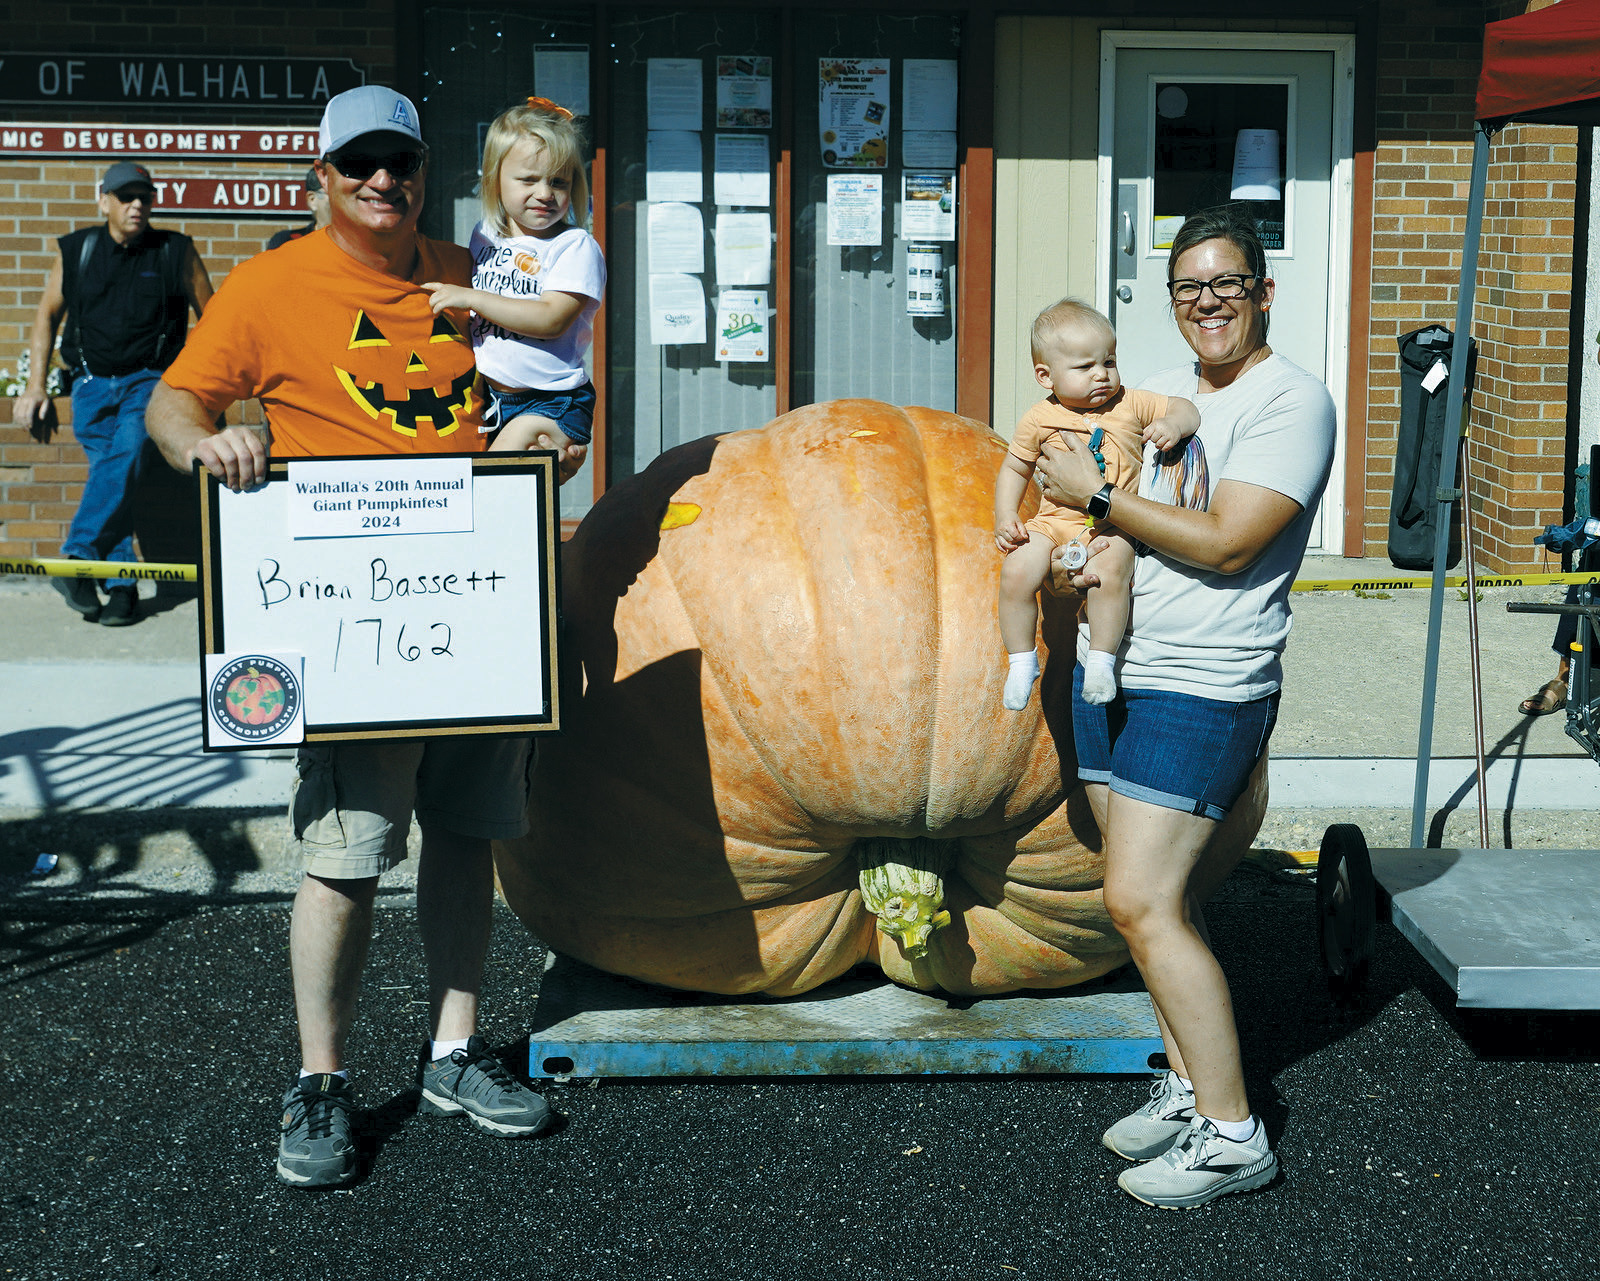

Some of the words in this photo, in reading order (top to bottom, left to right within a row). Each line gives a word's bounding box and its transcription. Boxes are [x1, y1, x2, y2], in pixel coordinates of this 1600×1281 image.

[39, 61, 86, 95] OF
[119, 61, 331, 100] WALHALLA
[393, 100, 412, 126] A
[63, 130, 242, 151] DEVELOPMENT
[259, 133, 320, 151] OFFI
[1256, 232, 1280, 240] PROUD
[728, 313, 754, 329] 30
[295, 480, 370, 495] Walhalla's
[374, 479, 410, 493] 20th
[413, 478, 465, 491] Annual
[313, 499, 352, 512] Giant
[356, 496, 449, 513] Pumpkinfest
[361, 516, 401, 529] 2024
[256, 558, 353, 610] Brian
[370, 558, 507, 603] Bassett
[333, 617, 455, 673] 1762
[216, 662, 244, 692] GREAT
[249, 659, 295, 690] PUMPKIN
[217, 705, 295, 736] COMMONWEALTH
